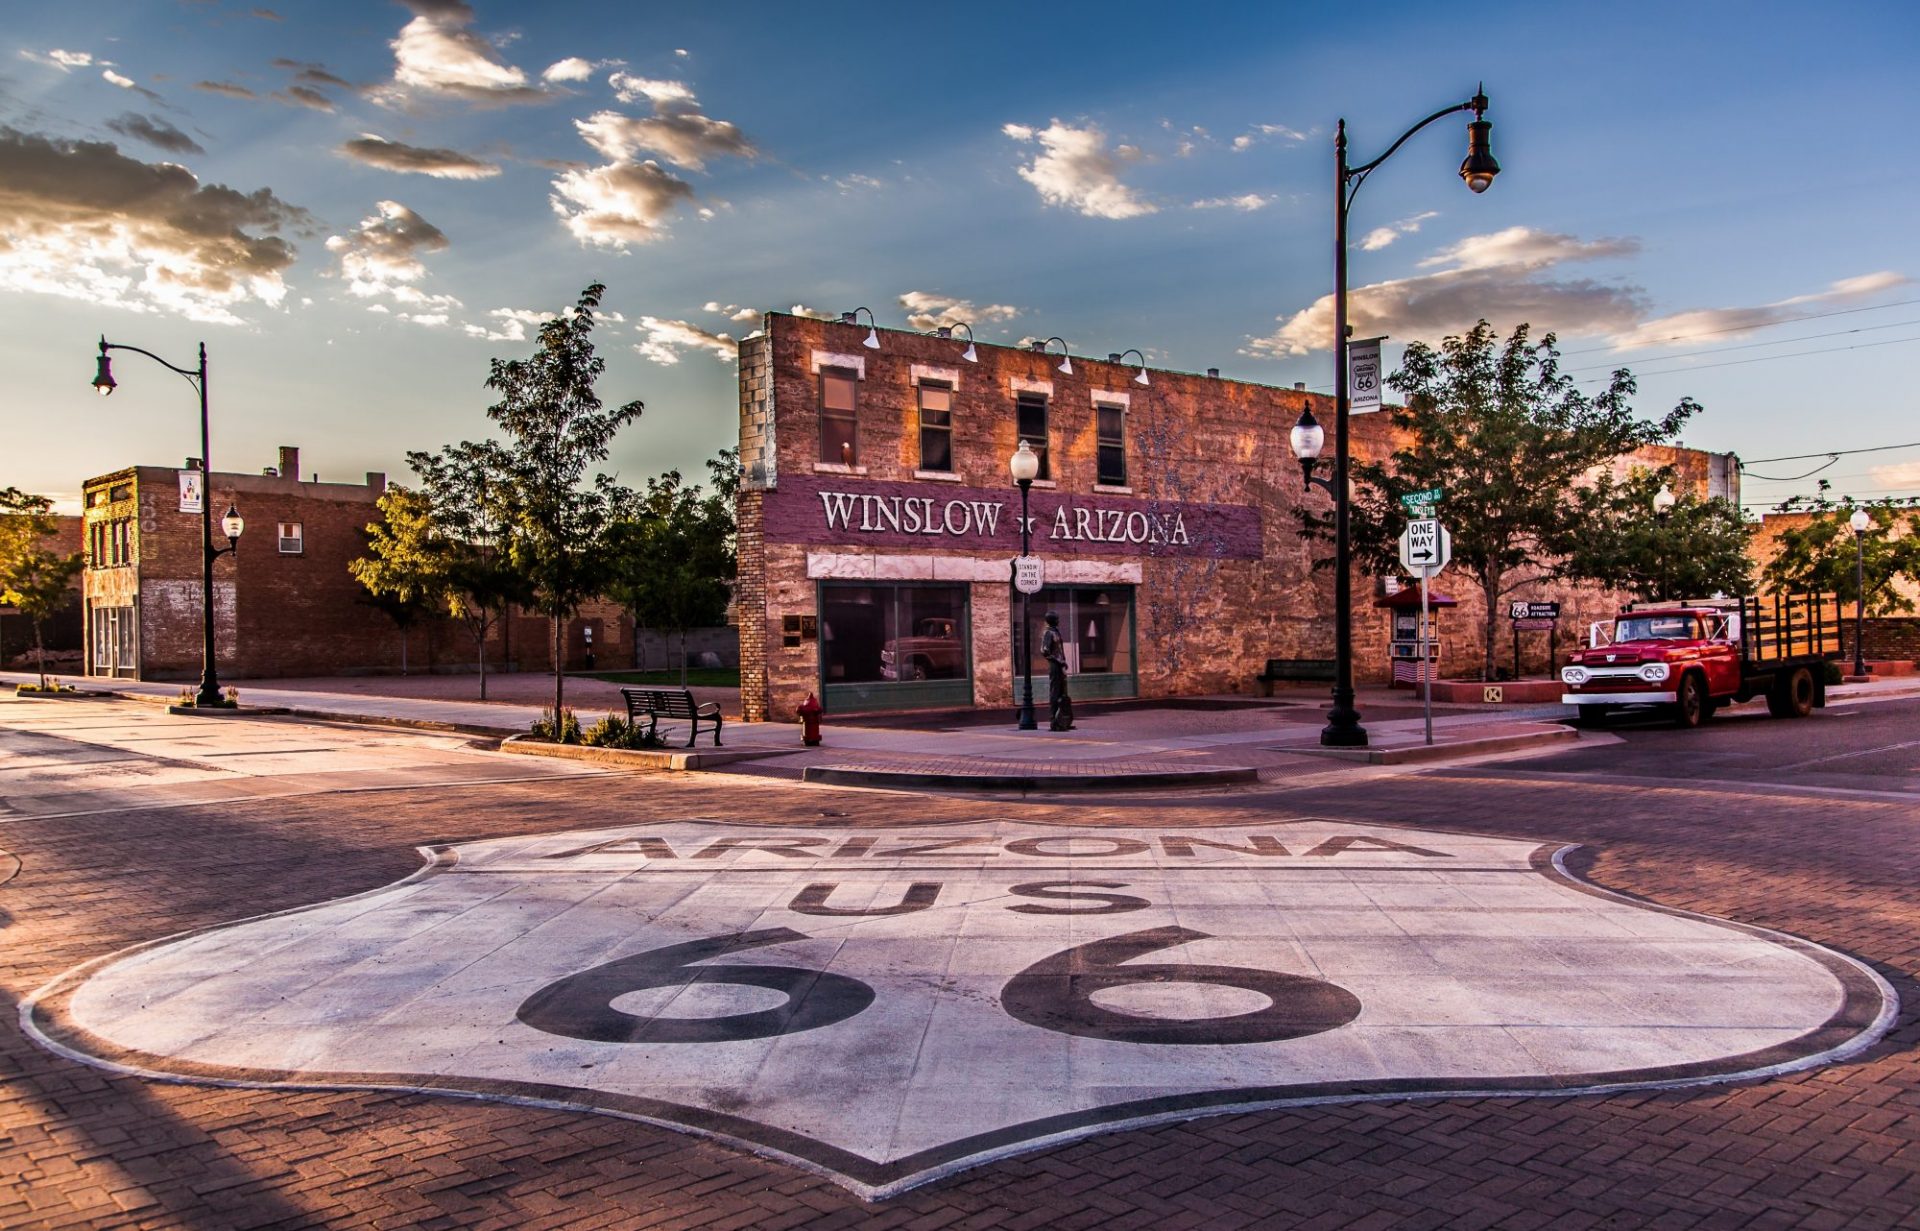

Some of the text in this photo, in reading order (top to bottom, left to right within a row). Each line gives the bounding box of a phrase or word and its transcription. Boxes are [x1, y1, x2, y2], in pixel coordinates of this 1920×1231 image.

[1358, 376, 1372, 388] 66
[1406, 492, 1432, 504] SECOND
[818, 491, 1189, 545] WINSLOW ARIZONA
[1411, 523, 1433, 534] ONE
[1411, 536, 1433, 548] WAY
[1514, 607, 1527, 616] 66
[539, 835, 1457, 859] ARIZONA
[516, 925, 1361, 1044] 66
